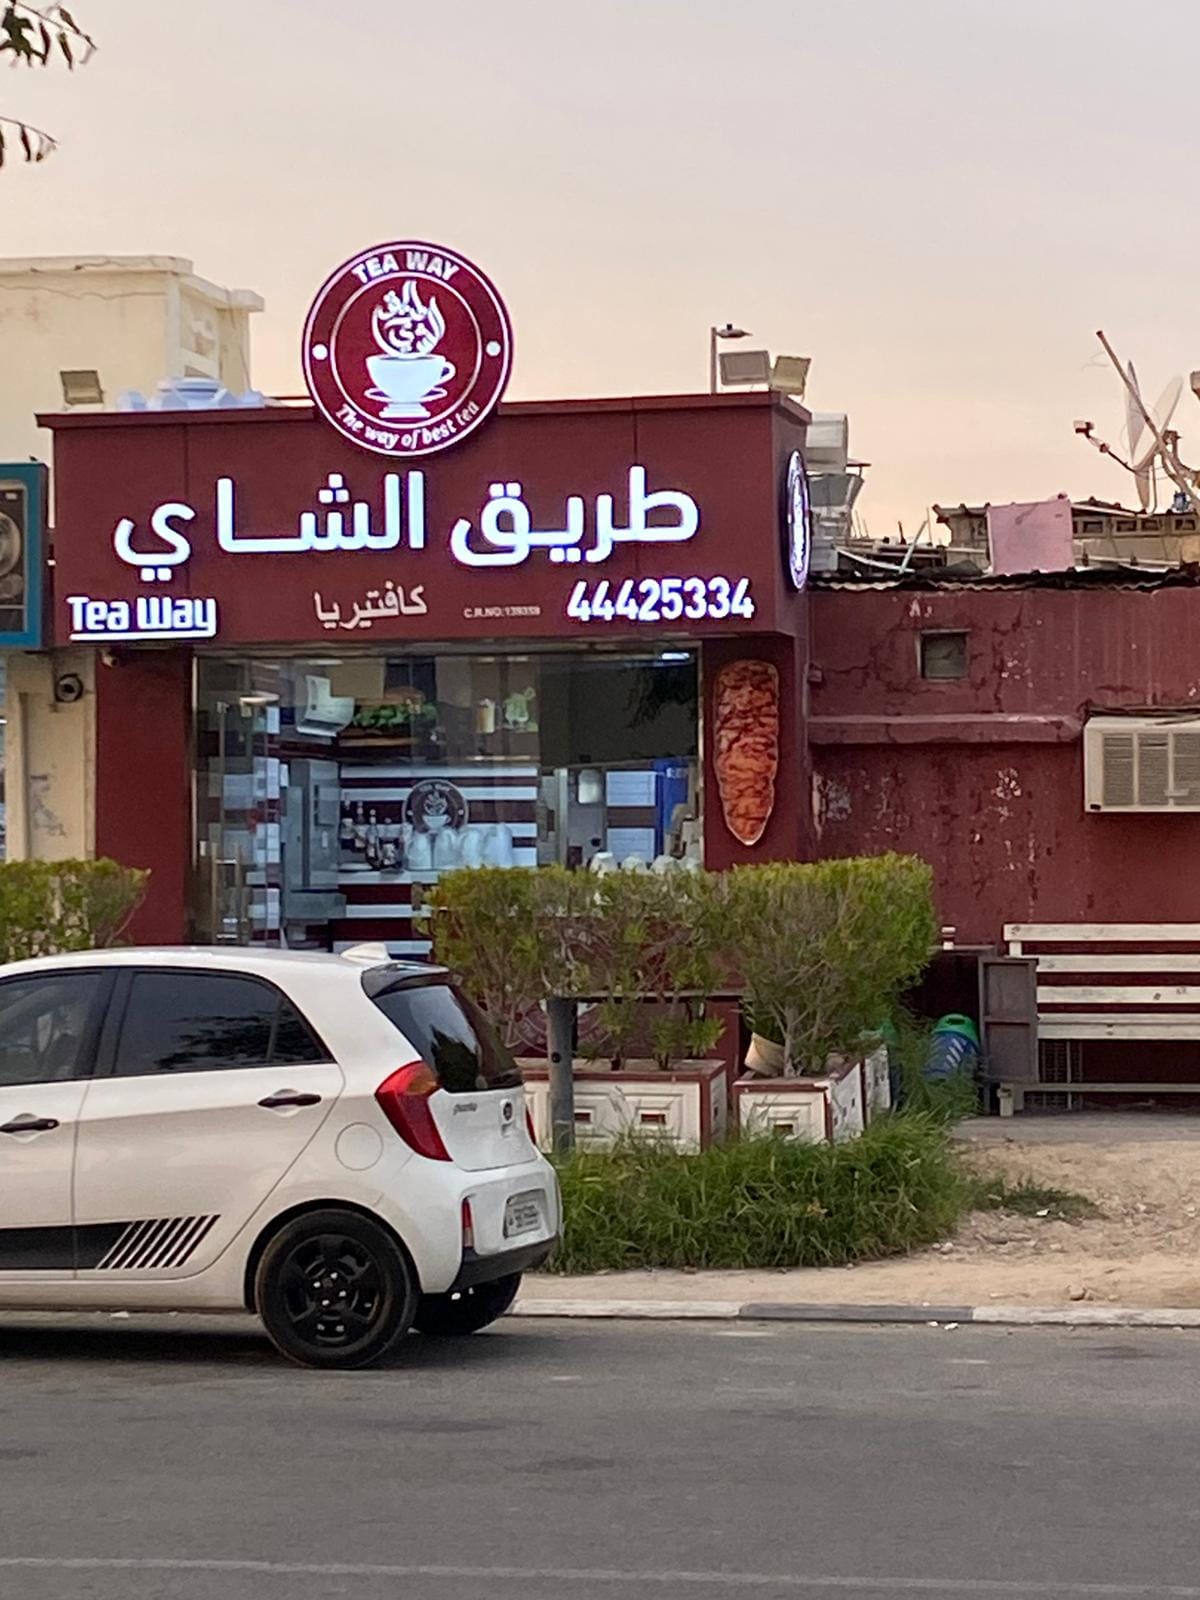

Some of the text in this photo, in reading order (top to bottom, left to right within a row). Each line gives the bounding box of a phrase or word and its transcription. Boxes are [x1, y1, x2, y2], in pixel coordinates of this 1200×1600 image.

[351, 251, 459, 284] TEA WAY
[336, 400, 480, 449] The way of best tea
[114, 470, 424, 582] الشاي
[450, 466, 699, 567] طريق
[66, 596, 216, 638] Tea Way
[314, 580, 428, 629] كافتيريا
[567, 577, 754, 621] 44425334
